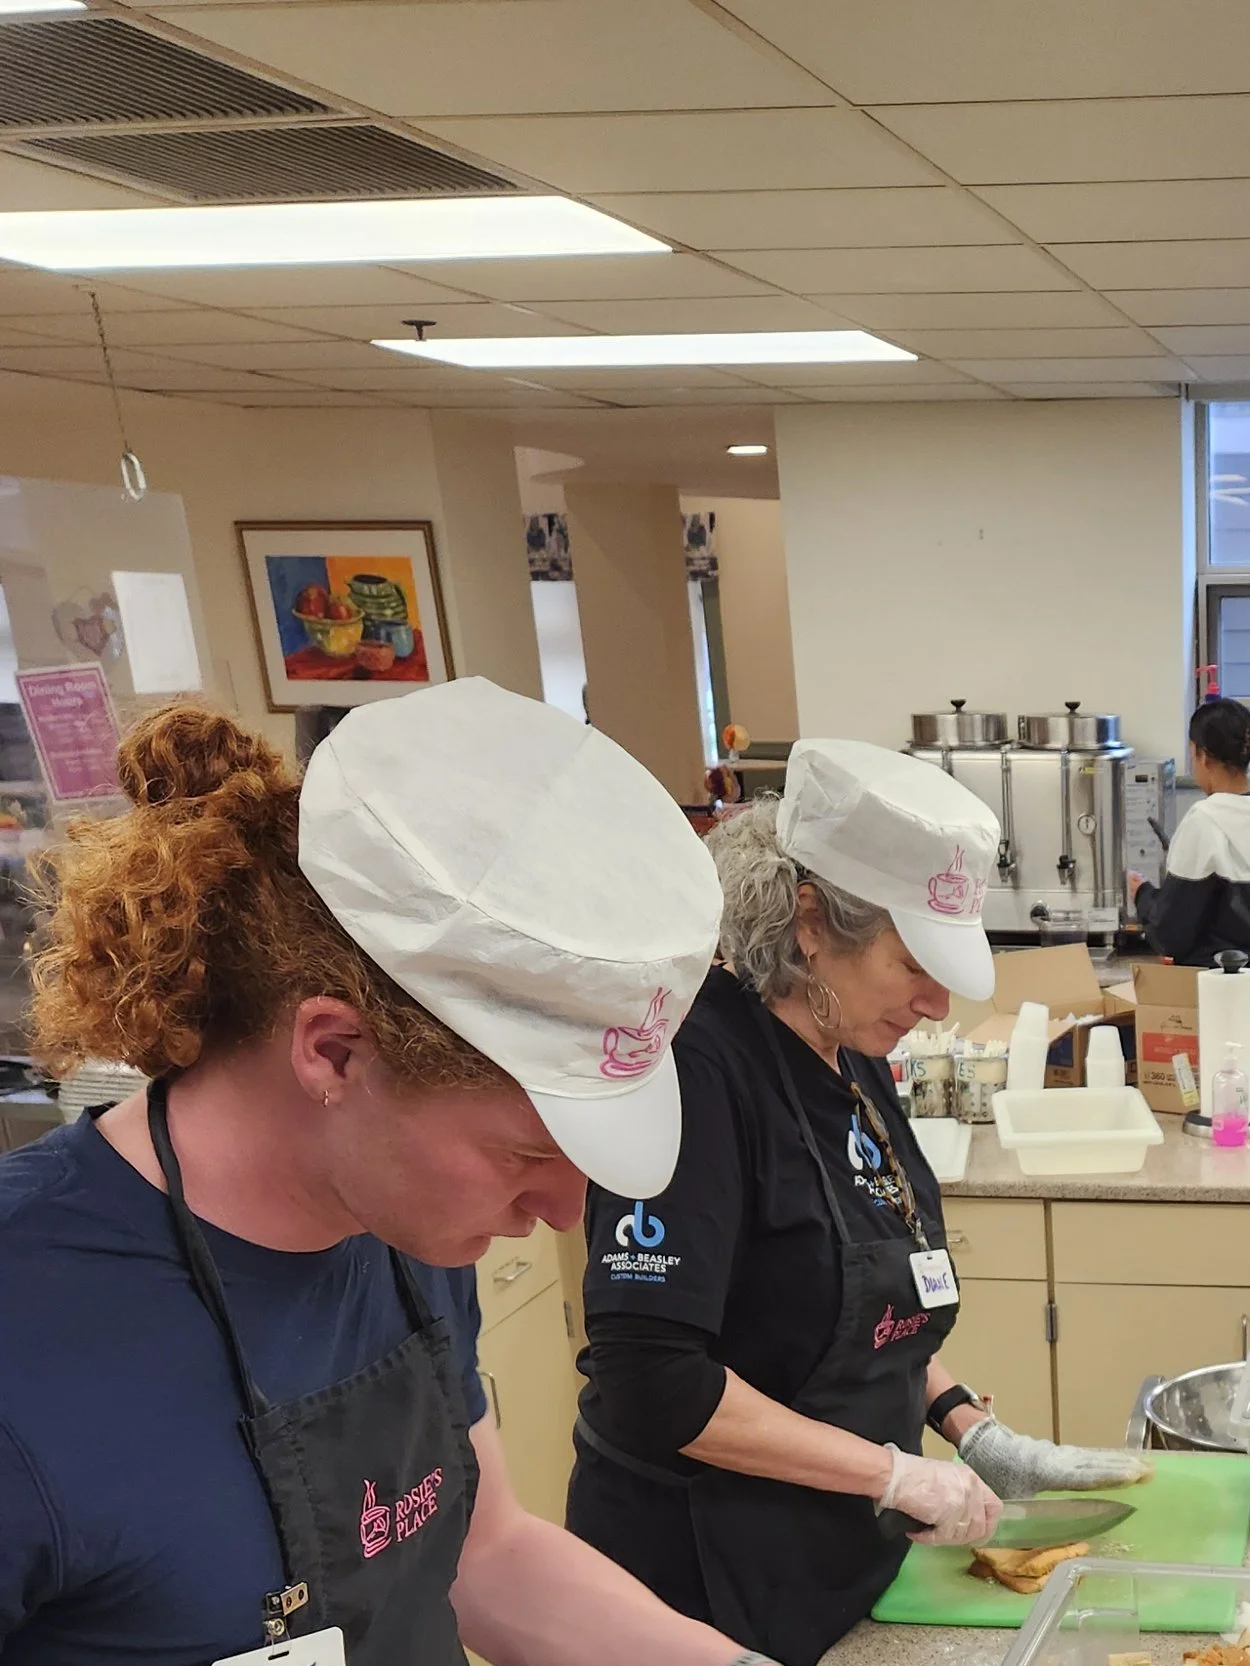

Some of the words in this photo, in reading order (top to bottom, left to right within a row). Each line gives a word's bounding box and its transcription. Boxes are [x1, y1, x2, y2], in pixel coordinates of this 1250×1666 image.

[601, 1252, 629, 1263] ADAMS
[637, 1252, 681, 1266] BEASLEY
[610, 1261, 667, 1273] ASSOCIATES
[610, 1272, 633, 1281] CUSTOM
[634, 1274, 666, 1283] BUILDERS
[394, 1467, 444, 1522] ROSIE'S
[396, 1492, 438, 1543] PLACE
